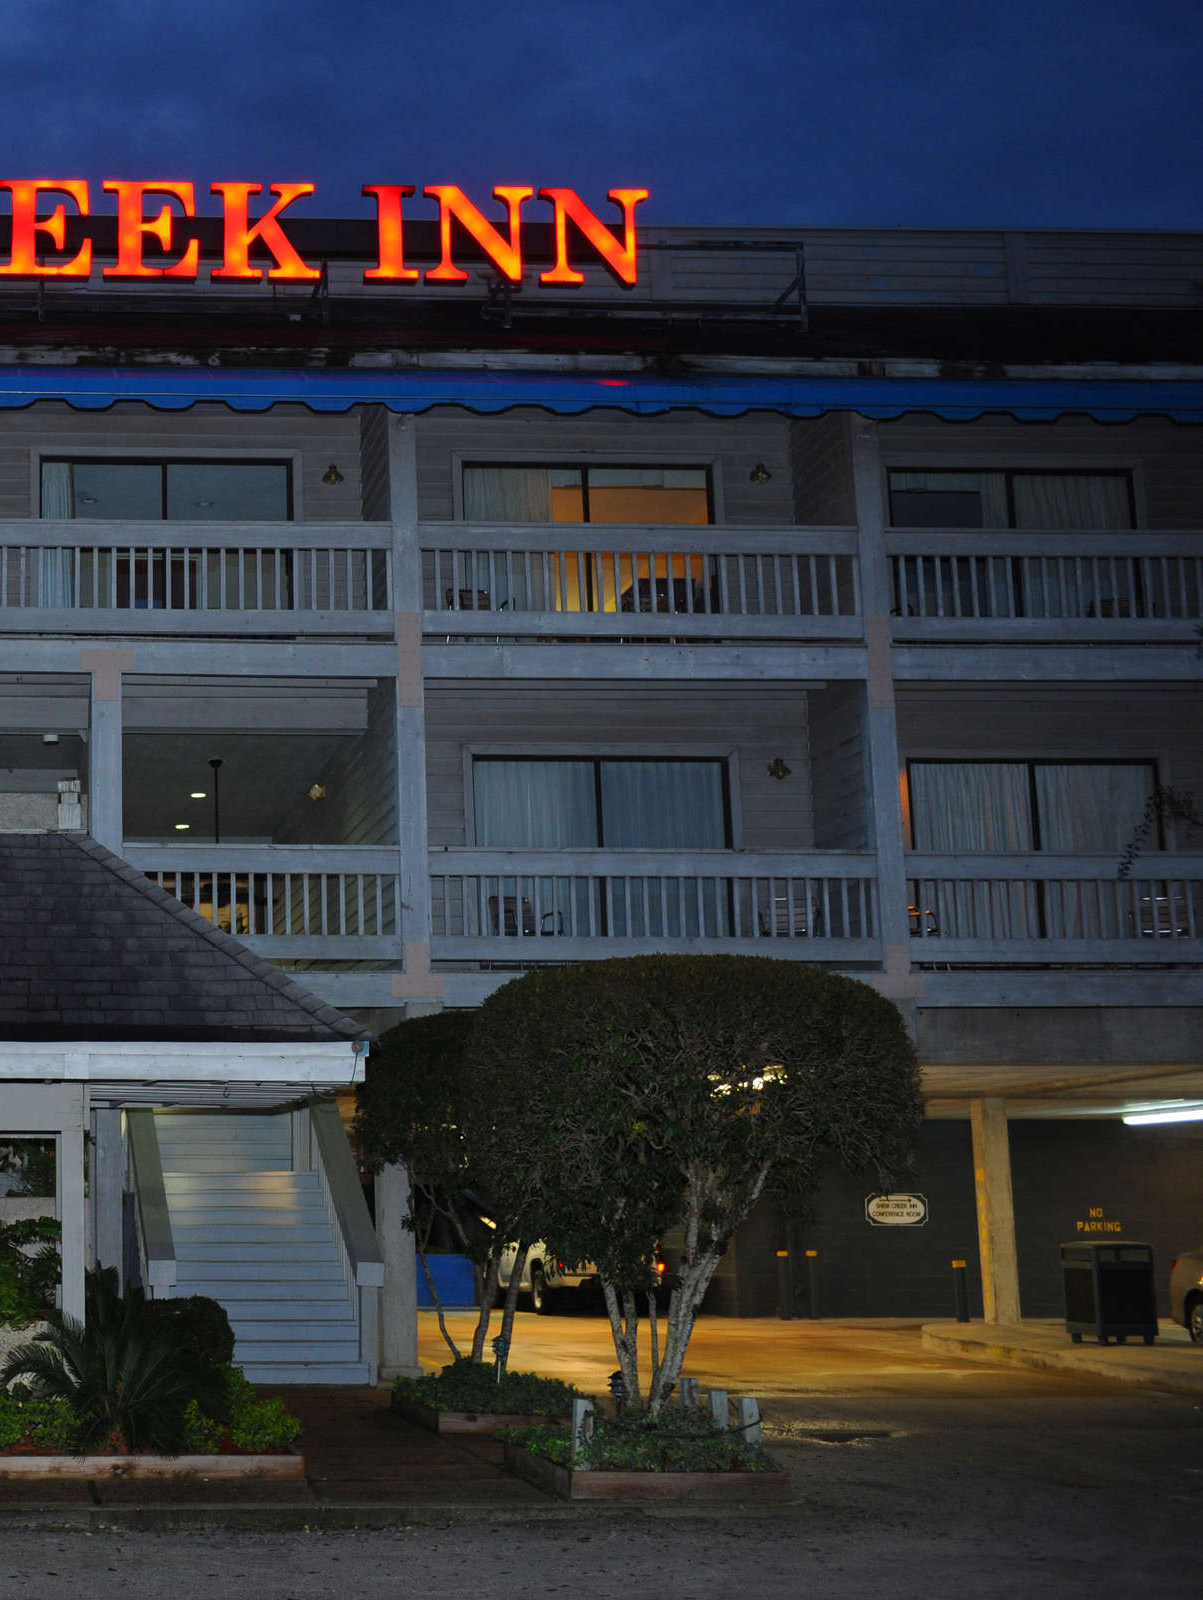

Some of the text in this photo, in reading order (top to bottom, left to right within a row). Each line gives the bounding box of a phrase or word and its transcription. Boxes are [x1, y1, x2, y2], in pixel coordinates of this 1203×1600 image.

[360, 183, 650, 288] INN
[1089, 1207, 1103, 1218] NO
[1076, 1220, 1122, 1232] PARKING
